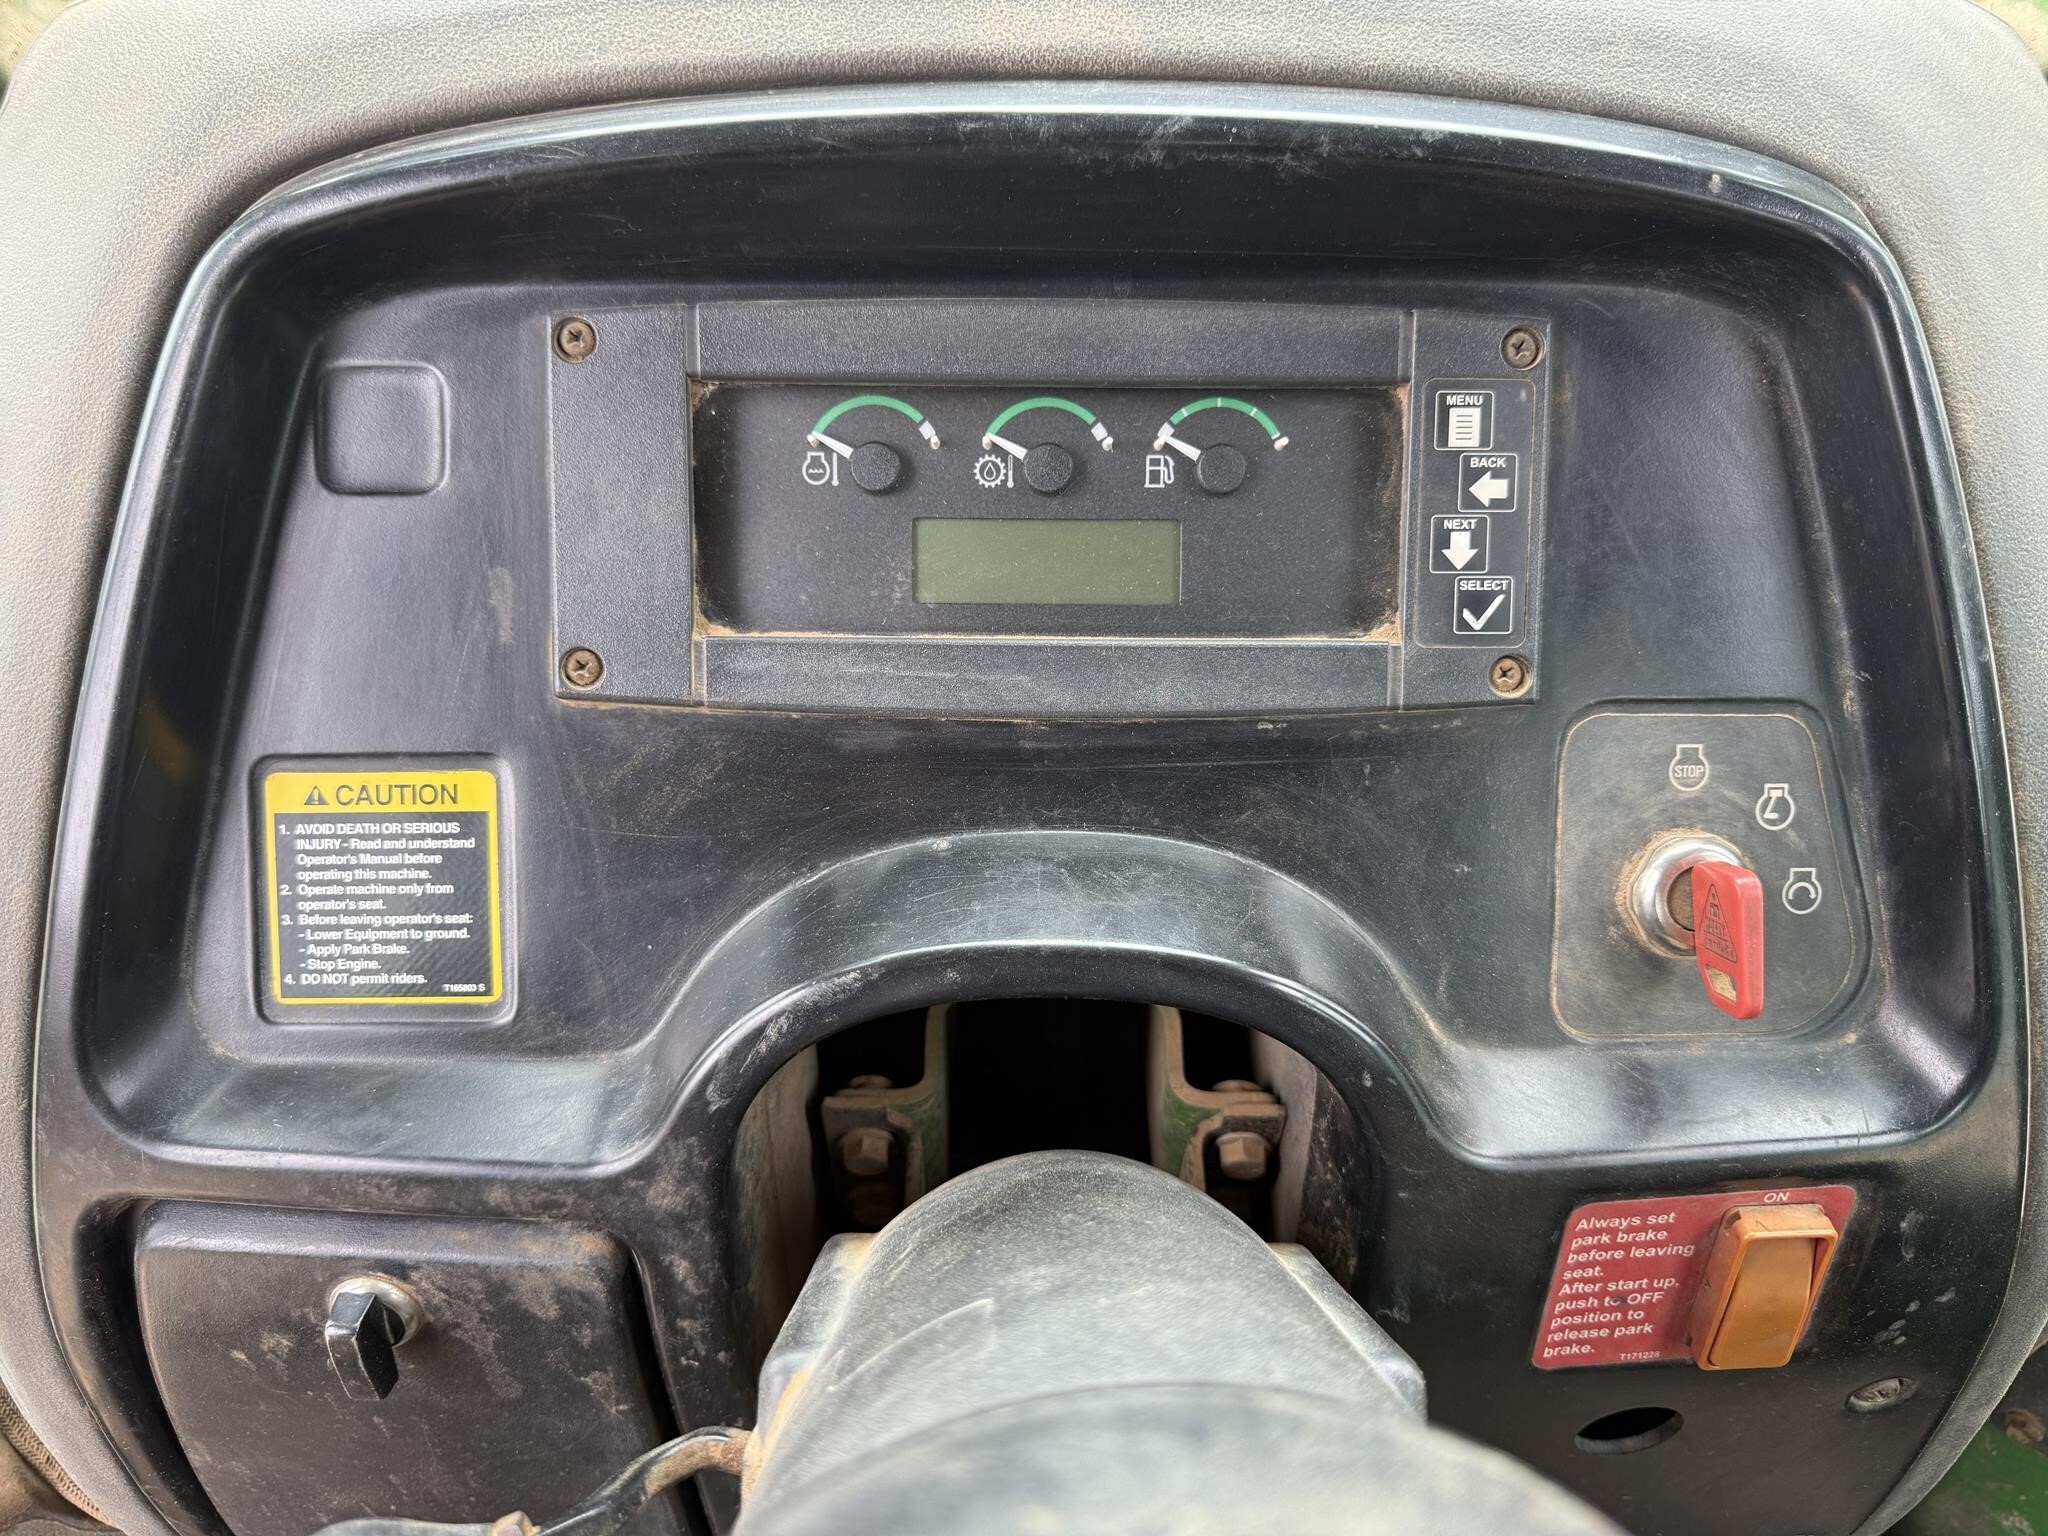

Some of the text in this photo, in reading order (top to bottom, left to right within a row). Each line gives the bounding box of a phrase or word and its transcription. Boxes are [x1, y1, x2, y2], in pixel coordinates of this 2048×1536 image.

[1446, 395, 1482, 405] MENU
[1470, 457, 1506, 468] BACK
[1443, 519, 1477, 530] NEXT
[1459, 580, 1508, 591] SELECT
[1674, 765, 1704, 778] STOP
[335, 784, 459, 805] CAUTION
[279, 821, 461, 835] 1. AVOID DEATH OR SERIOUS
[296, 838, 341, 850] INJURY
[351, 837, 381, 849] Read
[383, 837, 406, 849] and
[408, 837, 476, 849] understand
[296, 852, 443, 867] Operator's Manual before
[296, 867, 433, 883] operating this machine.
[280, 882, 455, 898] 2. Operate machine only from
[296, 898, 387, 913] operator's seat.
[281, 912, 474, 928] 3. Before leaving operator's seat:
[306, 928, 344, 940] Lower
[344, 928, 409, 942] Equipment
[409, 928, 424, 939] to
[424, 927, 471, 943] ground.
[307, 943, 341, 958] Apply
[343, 943, 371, 955] Park
[372, 943, 411, 954] Brake.
[307, 958, 336, 972] Stop
[337, 958, 382, 972] Engine.
[284, 972, 428, 987] 4. DO NOT permit riders.
[479, 983, 486, 991] S
[1763, 1192, 1790, 1204] ON
[1575, 1211, 1677, 1231] Always set
[1570, 1228, 1668, 1251] park brake
[1567, 1243, 1696, 1264] before leaving
[1562, 1265, 1605, 1281] seat.
[1558, 1282, 1603, 1296] After
[1606, 1278, 1649, 1292] start
[1554, 1291, 1665, 1315] push to OFF
[1550, 1309, 1645, 1330] position to
[1546, 1322, 1654, 1344] release park
[1543, 1343, 1596, 1359] brake.
